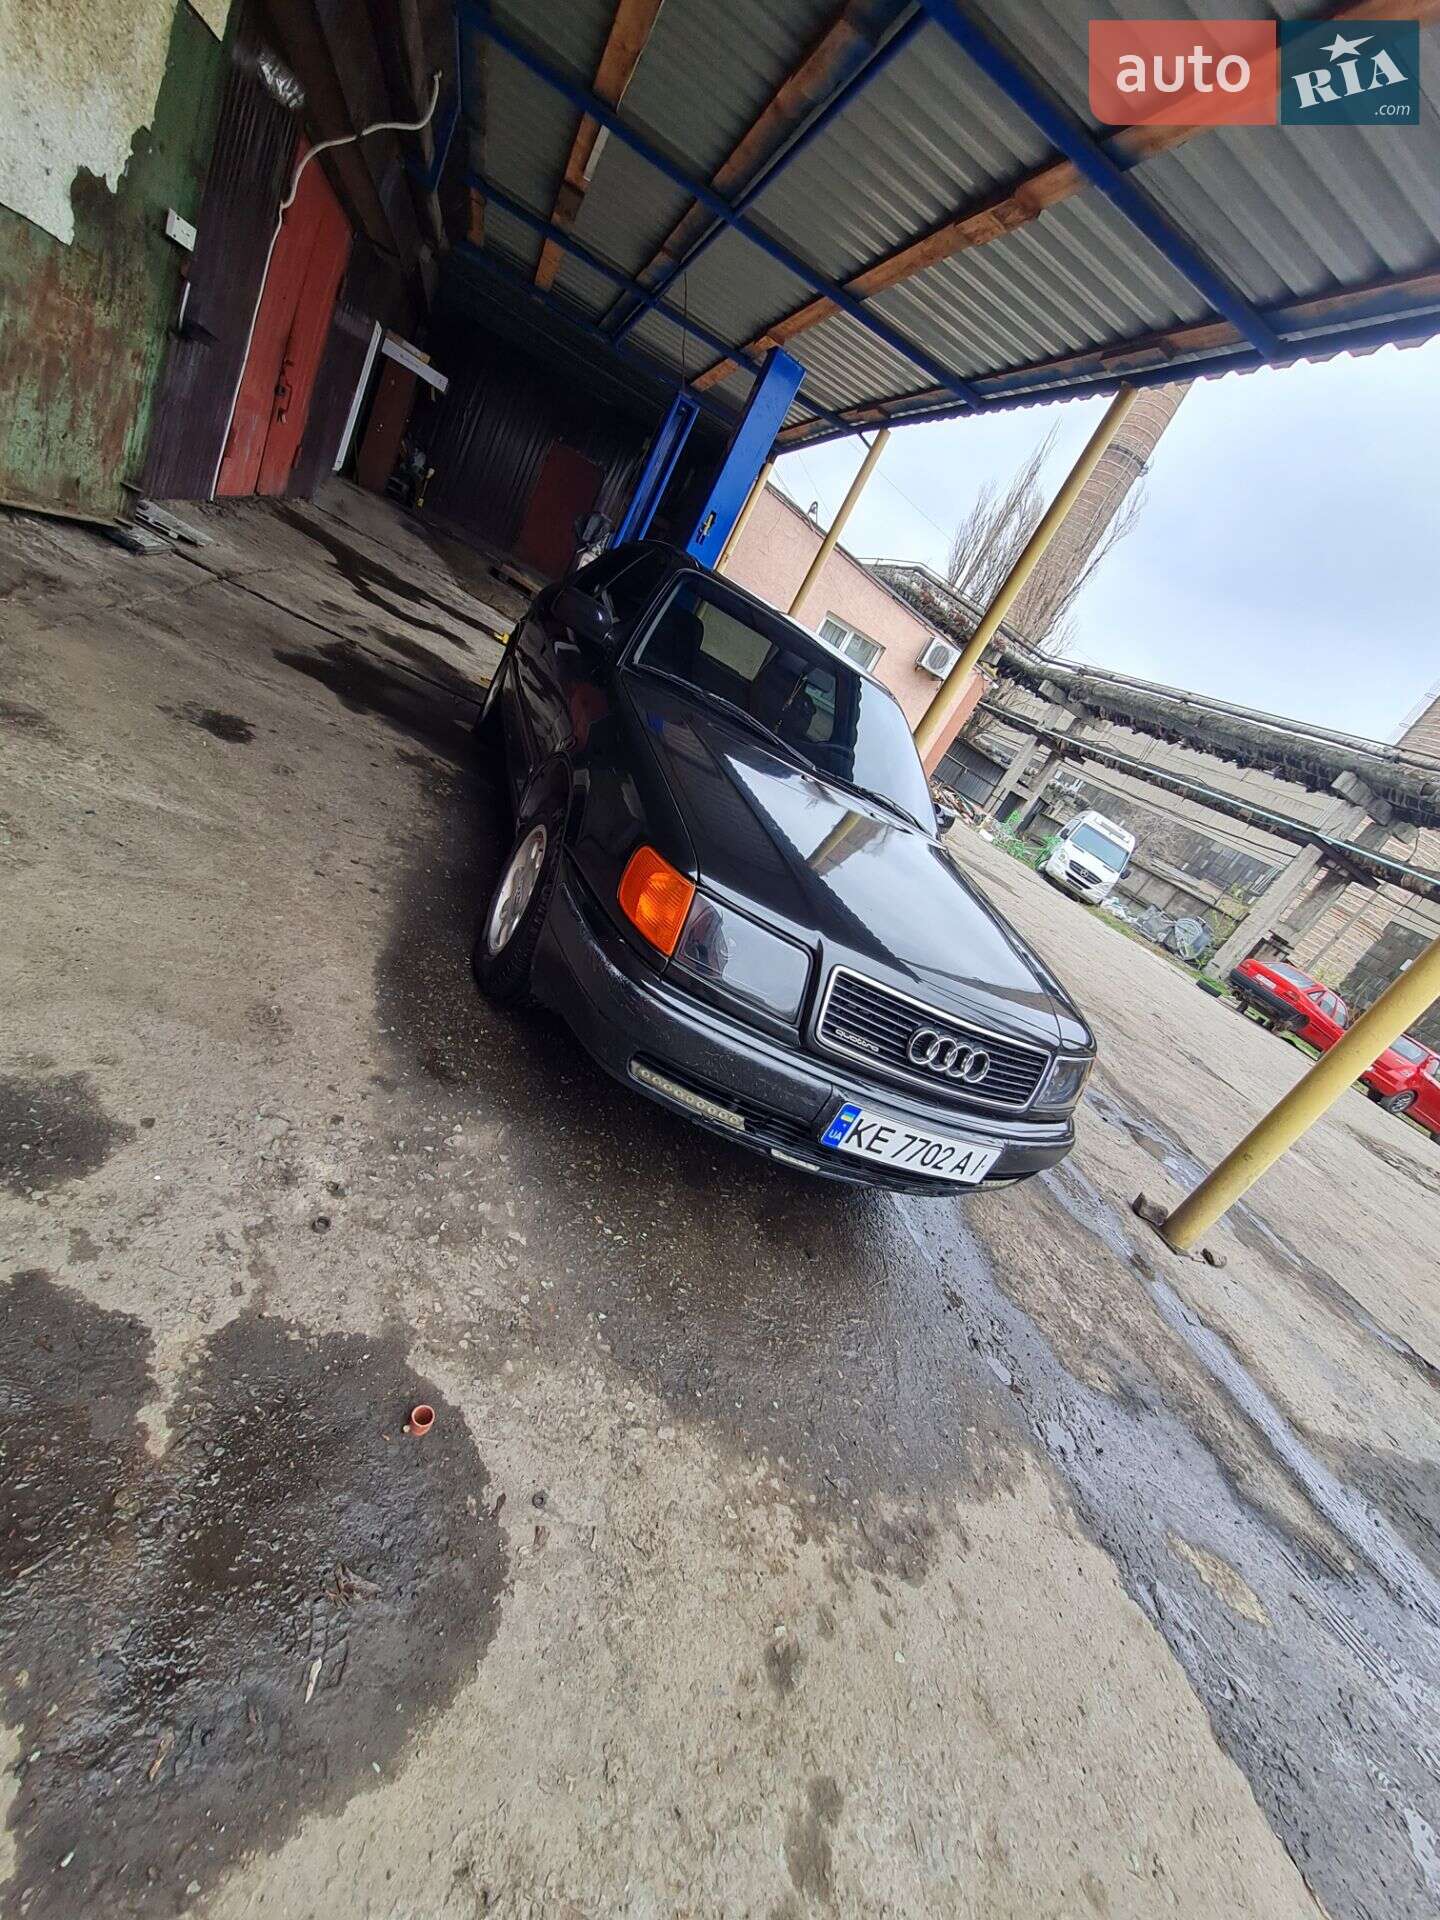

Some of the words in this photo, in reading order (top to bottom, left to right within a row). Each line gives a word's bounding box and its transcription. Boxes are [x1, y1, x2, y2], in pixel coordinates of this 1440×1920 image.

[829, 1129, 842, 1141] UA
[845, 1118, 896, 1155] KE
[890, 1134, 956, 1171] 7702
